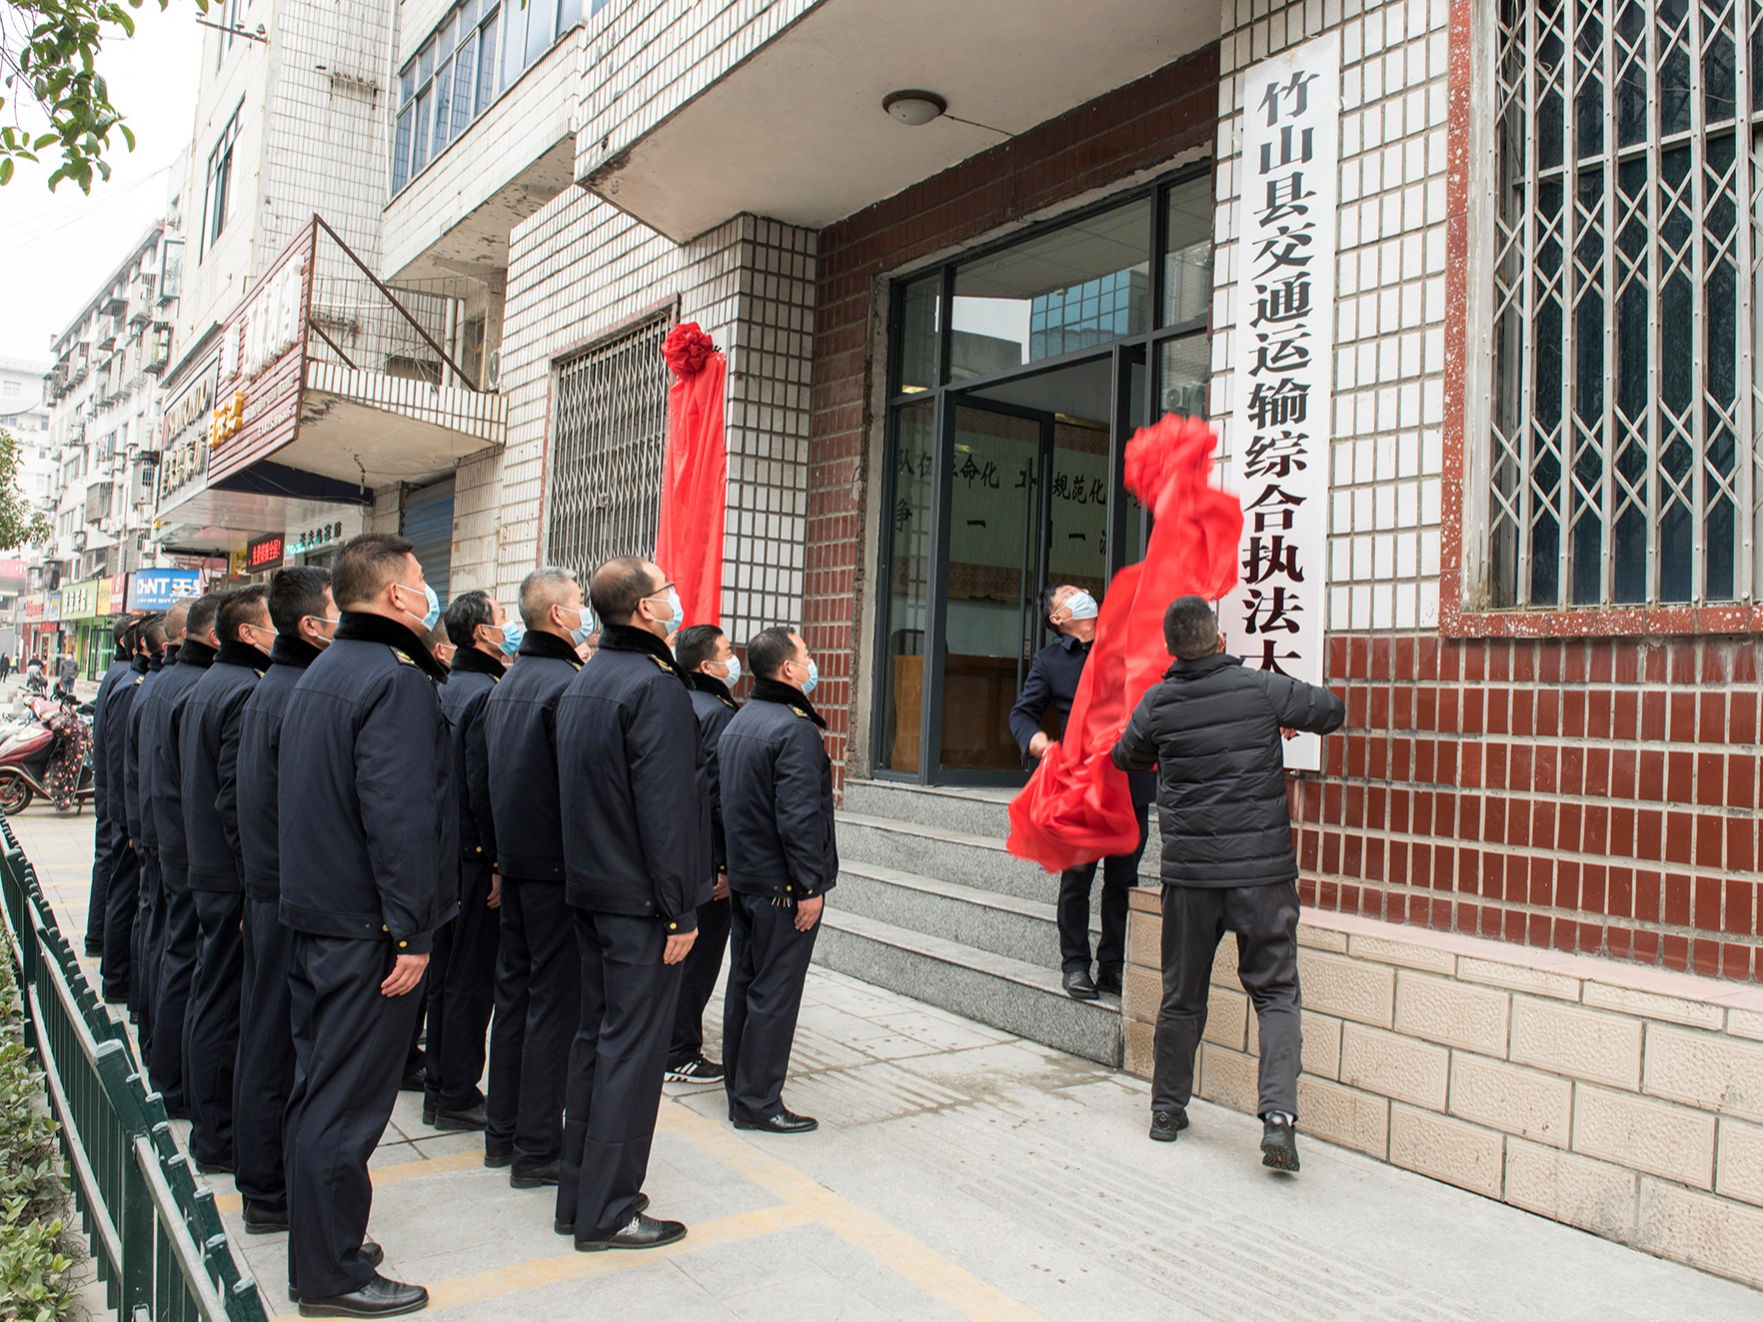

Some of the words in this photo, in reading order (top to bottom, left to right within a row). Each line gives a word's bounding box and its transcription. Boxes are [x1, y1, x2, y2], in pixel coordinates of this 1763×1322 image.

[1239, 69, 1320, 741] 竹山县交通运输综合执法大
[897, 448, 999, 489] 队伍命化
[1014, 470, 1106, 505] 工规范化
